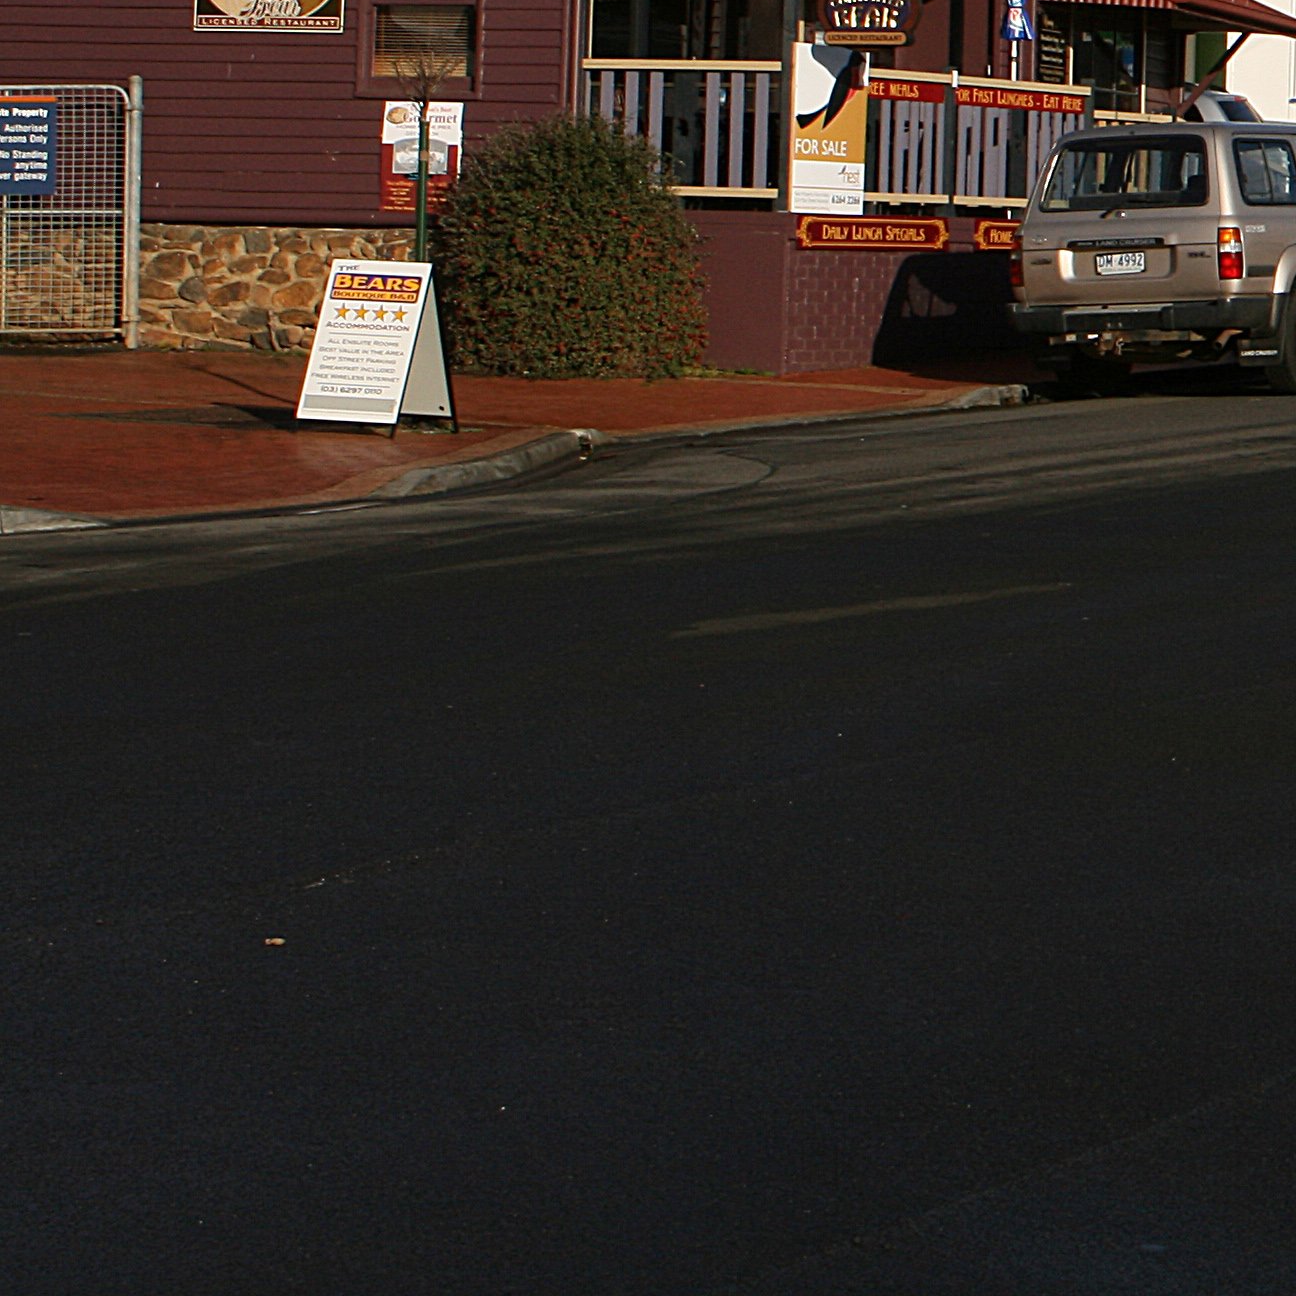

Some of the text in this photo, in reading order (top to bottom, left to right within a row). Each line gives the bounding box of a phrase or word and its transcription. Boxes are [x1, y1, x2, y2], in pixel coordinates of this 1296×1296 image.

[264, 19, 335, 27] RESTAURANT
[890, 83, 919, 98] MEALS
[973, 88, 1082, 111] FAST LUNCHES EAT HERE
[12, 107, 48, 118] Property
[403, 113, 457, 124] Gormet
[4, 124, 48, 132] Authorised
[29, 134, 48, 144] Only
[795, 138, 847, 157] FOR SALE
[12, 150, 48, 160] Standing
[14, 162, 47, 170] anytime
[14, 172, 48, 181] gateway
[822, 224, 925, 242] DAILY LUNCH SPECIALS
[990, 229, 1013, 244] HOME
[335, 275, 420, 291] BEARS
[334, 291, 384, 300] BOUTIQUE
[326, 321, 410, 332] ACCOMMODATION
